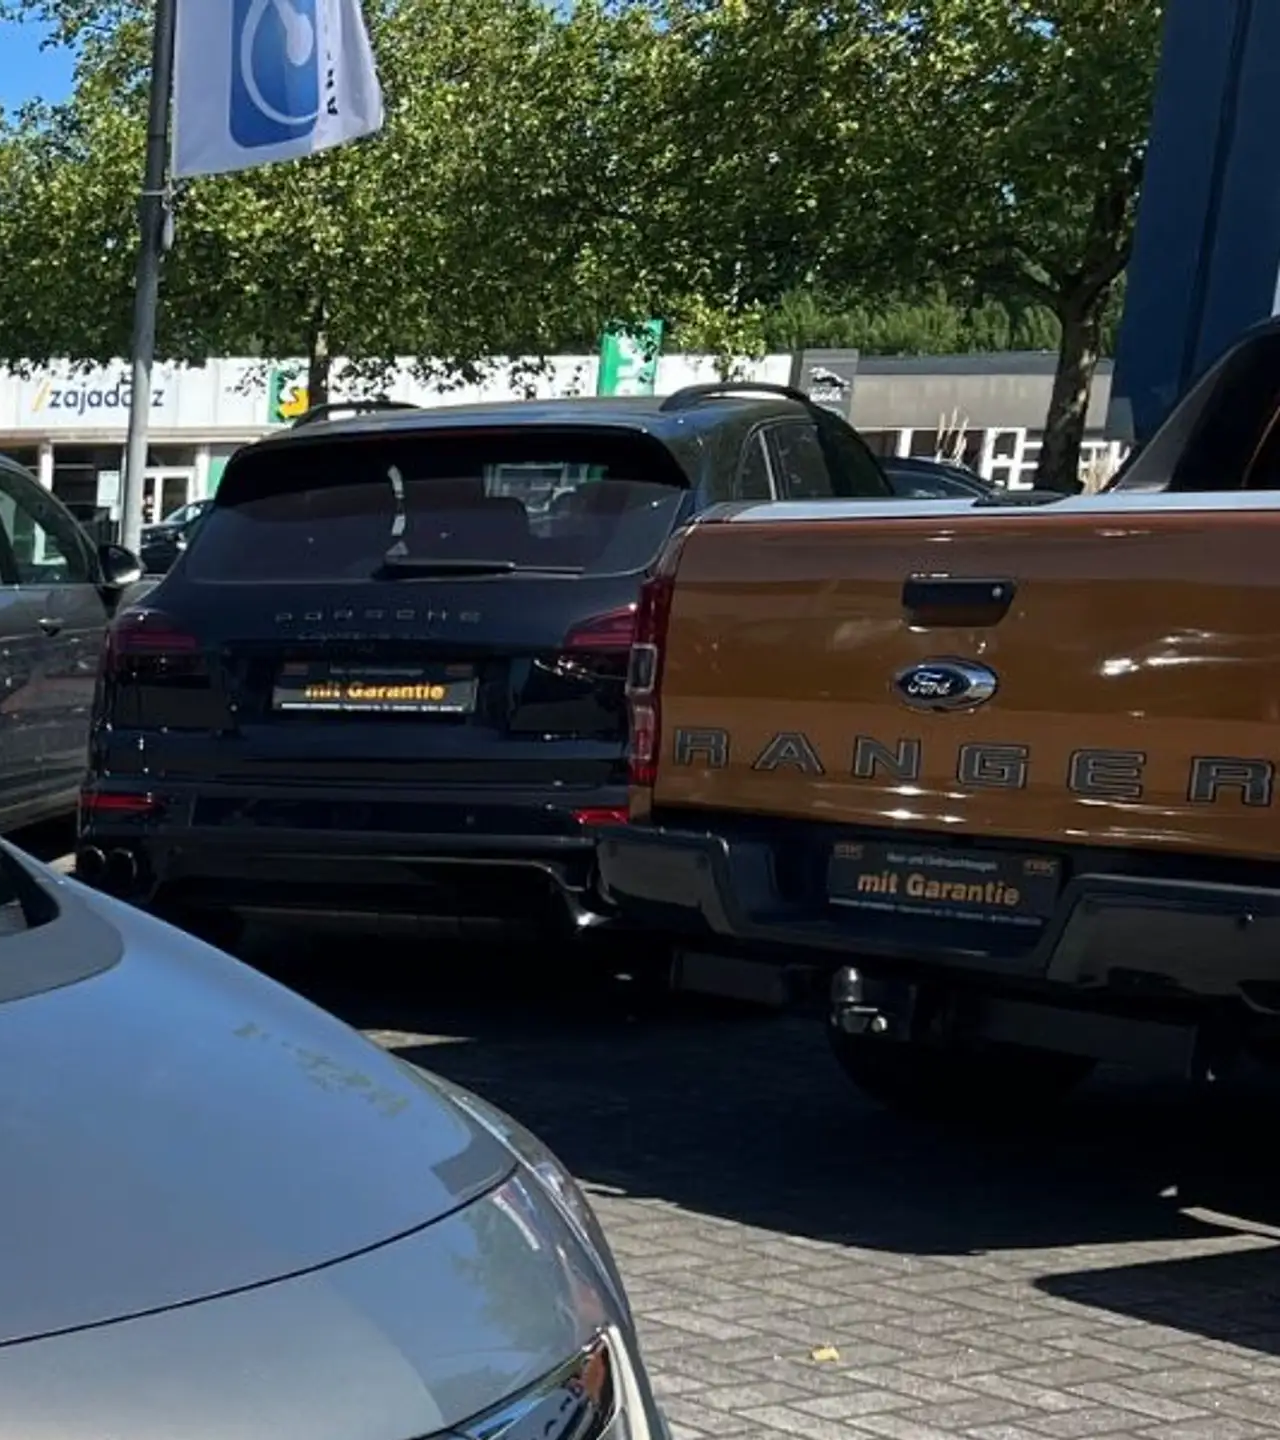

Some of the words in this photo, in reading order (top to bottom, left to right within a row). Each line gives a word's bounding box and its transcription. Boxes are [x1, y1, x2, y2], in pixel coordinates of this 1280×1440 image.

[305, 681, 341, 699] mit
[347, 681, 445, 700] Garantie
[907, 671, 953, 695] Ford
[672, 727, 1276, 806] RANGER
[857, 870, 898, 893] mit
[906, 872, 1021, 906] Garantie
